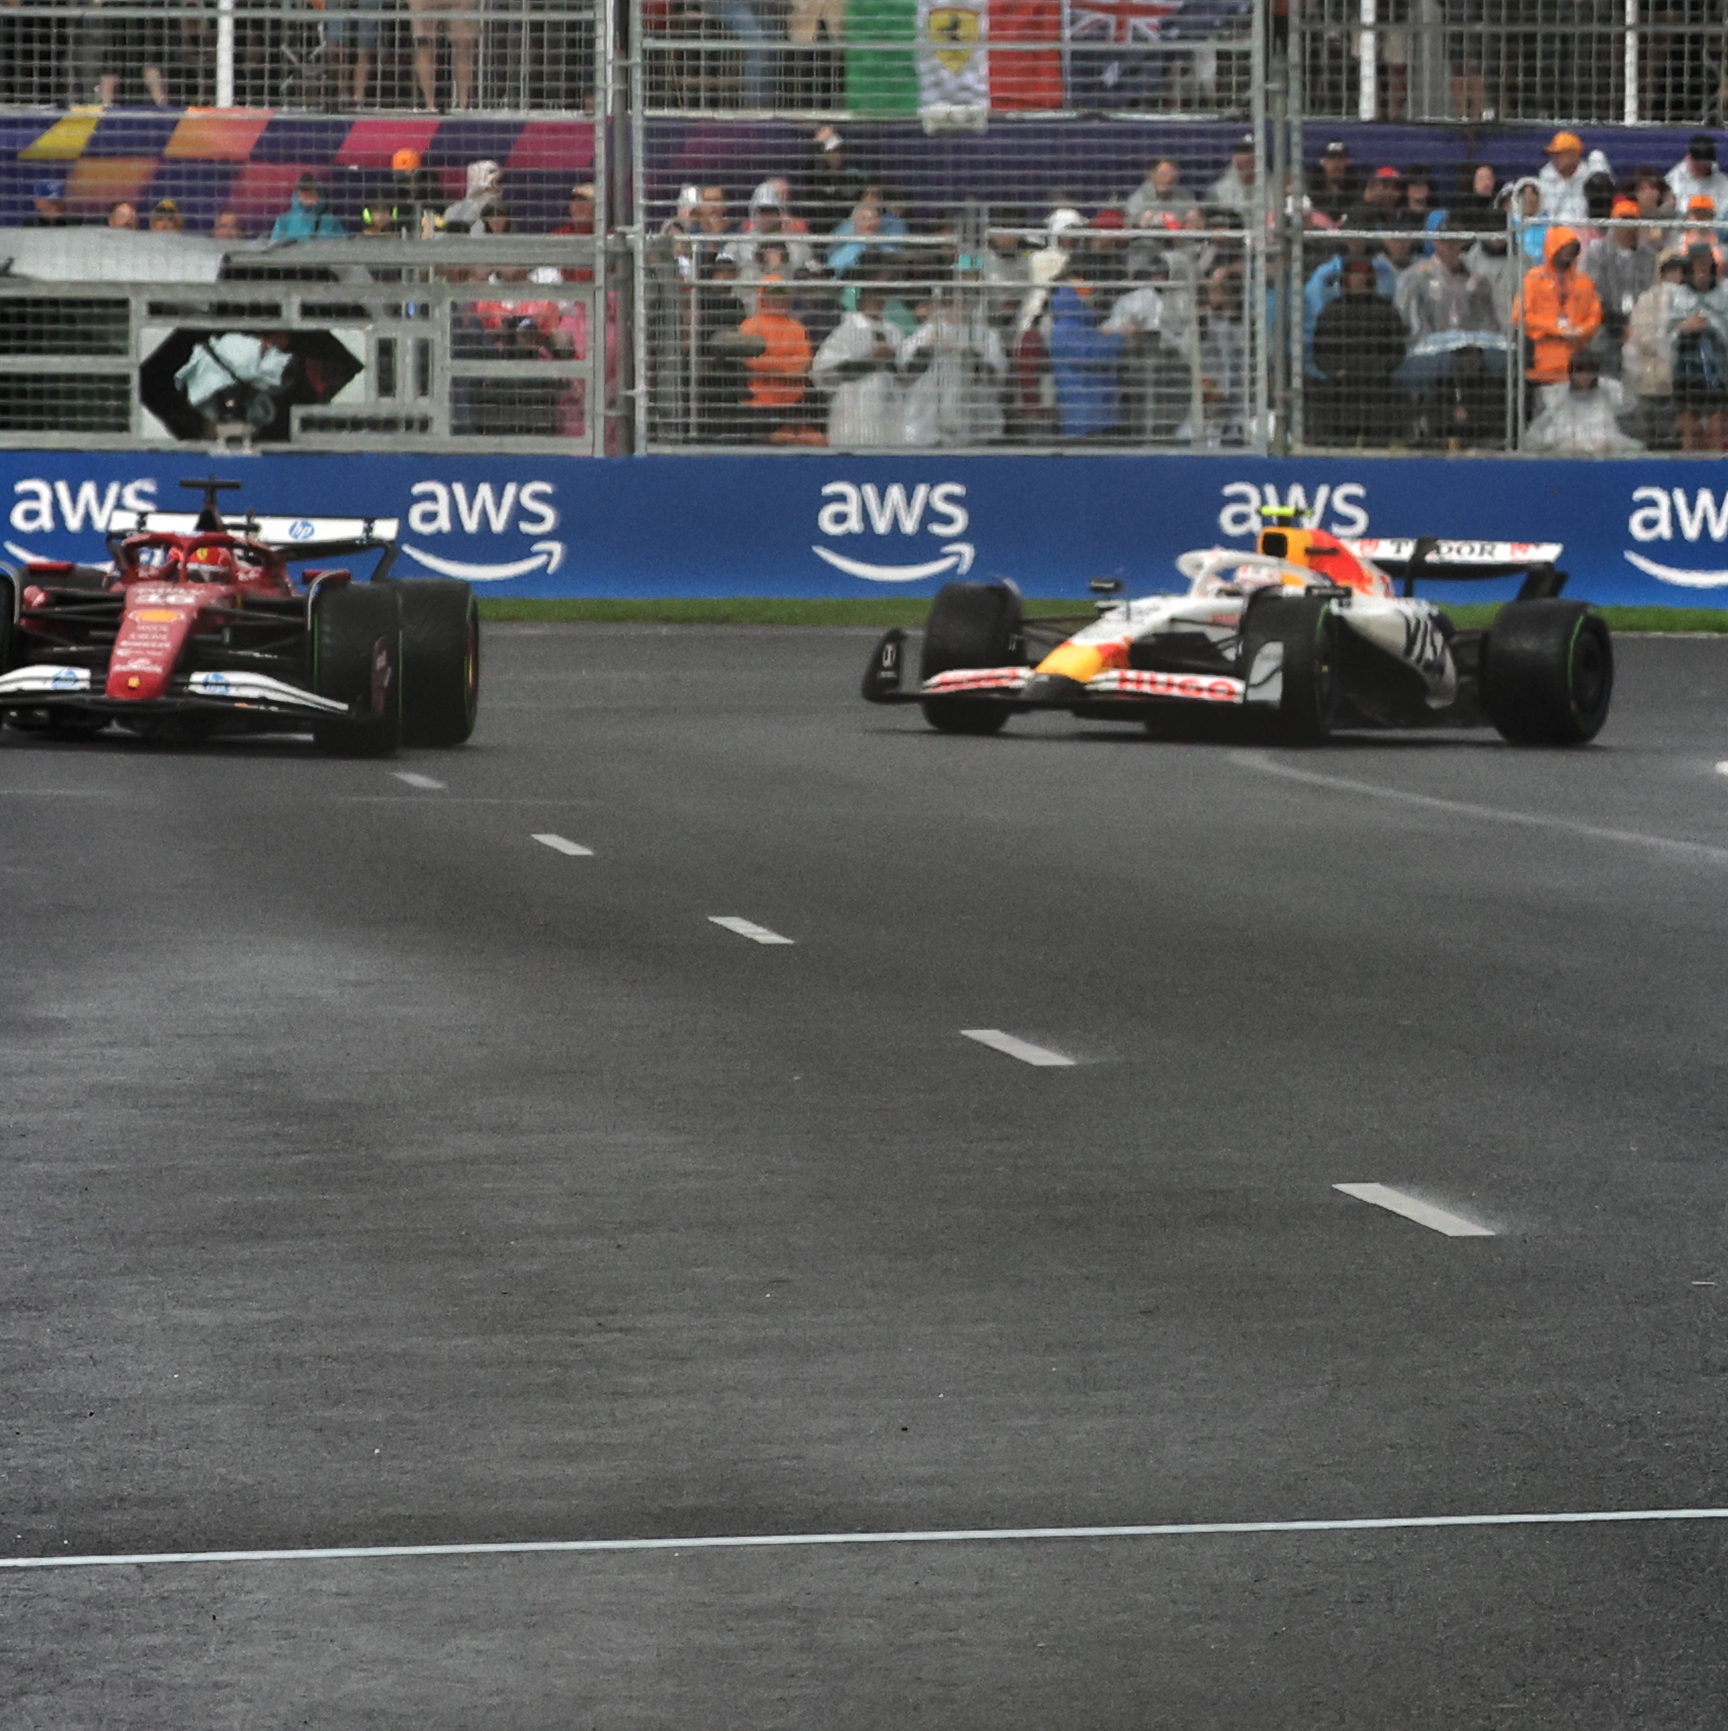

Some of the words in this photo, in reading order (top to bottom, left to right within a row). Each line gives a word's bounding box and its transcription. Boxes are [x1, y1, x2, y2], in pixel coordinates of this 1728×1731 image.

[11, 479, 158, 533] aws
[409, 481, 557, 535] aws
[819, 482, 968, 536] aws
[1220, 482, 1368, 536] aws
[1390, 540, 1498, 558] TDOR
[1117, 669, 1238, 701] HUGO
